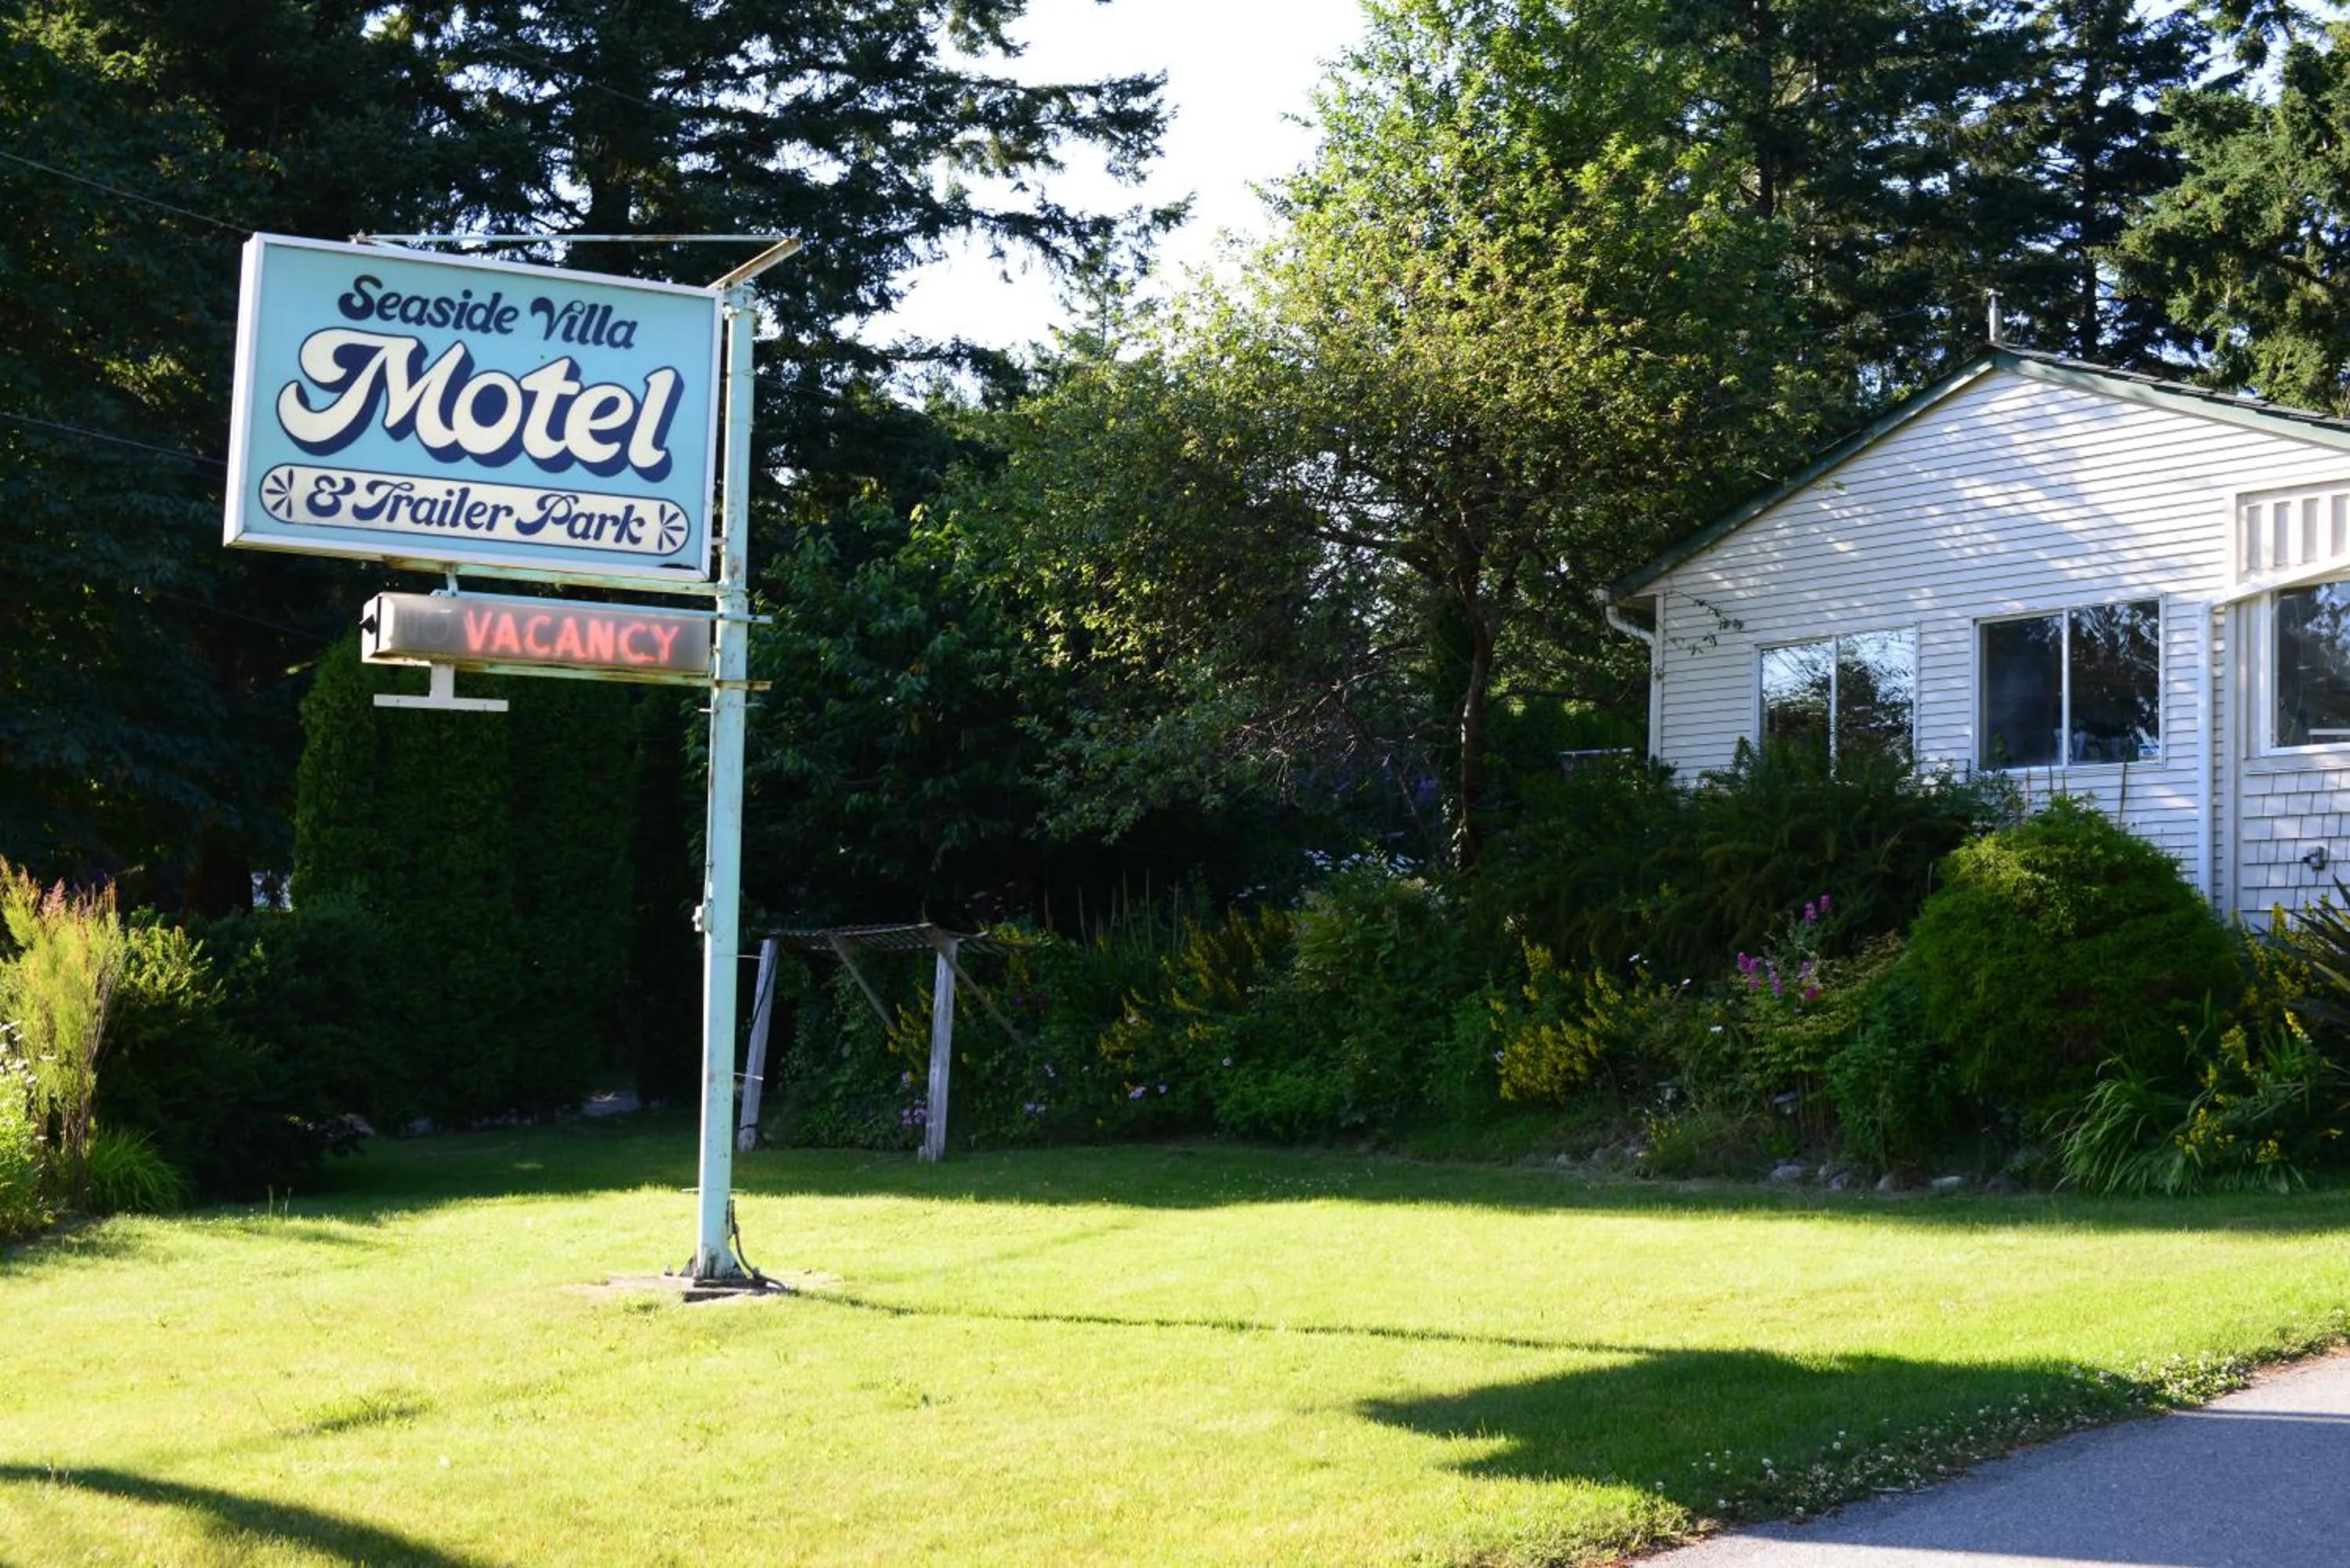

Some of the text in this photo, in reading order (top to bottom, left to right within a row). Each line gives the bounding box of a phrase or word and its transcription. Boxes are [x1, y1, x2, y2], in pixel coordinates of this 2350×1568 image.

[338, 275, 638, 349] Seaside Villa
[277, 327, 684, 482] Motel
[306, 475, 645, 544] & Trailer Park
[464, 610, 679, 663] VACANCY
